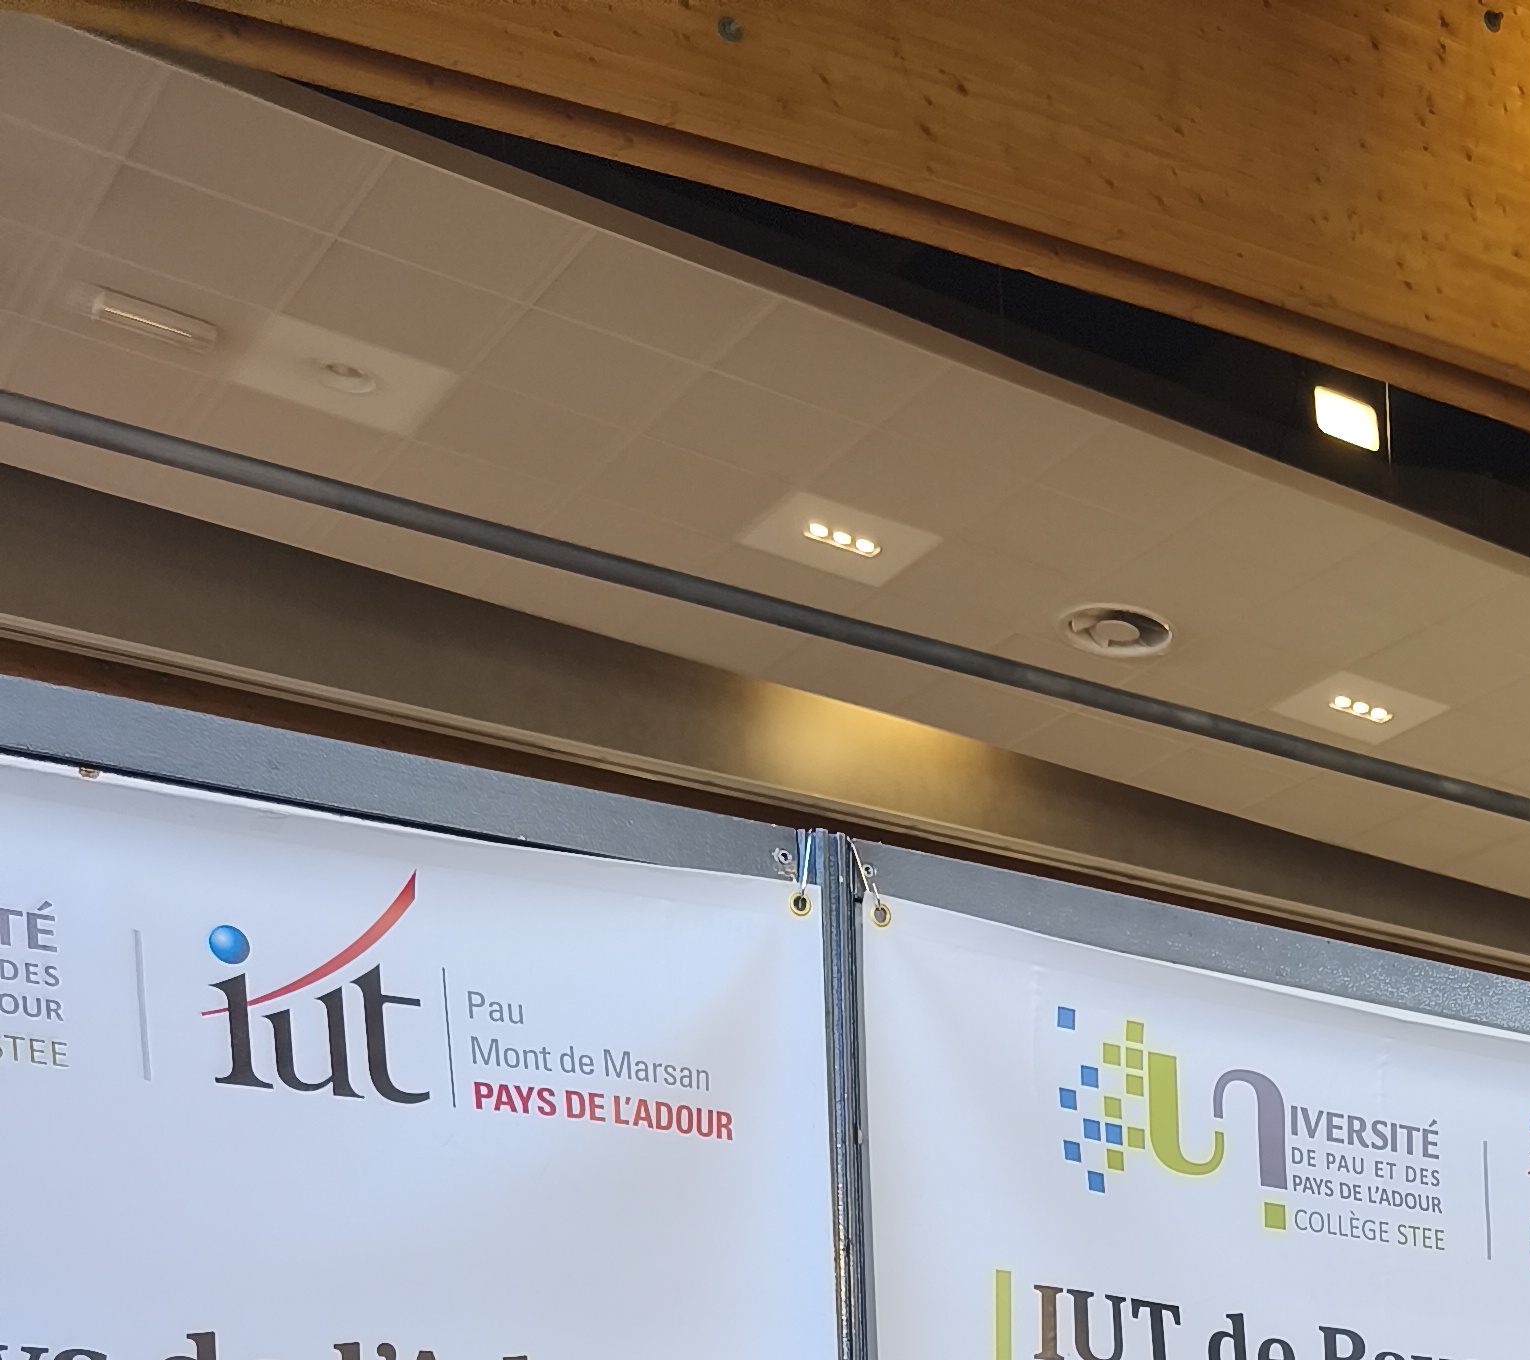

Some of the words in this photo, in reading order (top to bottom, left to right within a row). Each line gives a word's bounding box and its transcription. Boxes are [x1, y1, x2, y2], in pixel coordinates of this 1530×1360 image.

[0, 960, 60, 988] DES
[468, 990, 525, 1026] Pau
[470, 1037, 551, 1073] Mont
[559, 1043, 595, 1077] de
[603, 1048, 712, 1092] Marsan
[473, 1081, 558, 1120] PAYS
[565, 1090, 606, 1124] DE
[612, 1094, 734, 1142] L'ADOUR
[1290, 1146, 1319, 1167] DE
[1326, 1152, 1366, 1175] PAU
[1374, 1158, 1397, 1180] ET
[1404, 1163, 1441, 1188] DES
[1291, 1173, 1335, 1199] PAYS
[1339, 1180, 1364, 1203] DE
[1367, 1183, 1443, 1215] L'ADOUR
[1293, 1205, 1391, 1245] COLLÈGE
[1396, 1223, 1446, 1251] STEE
